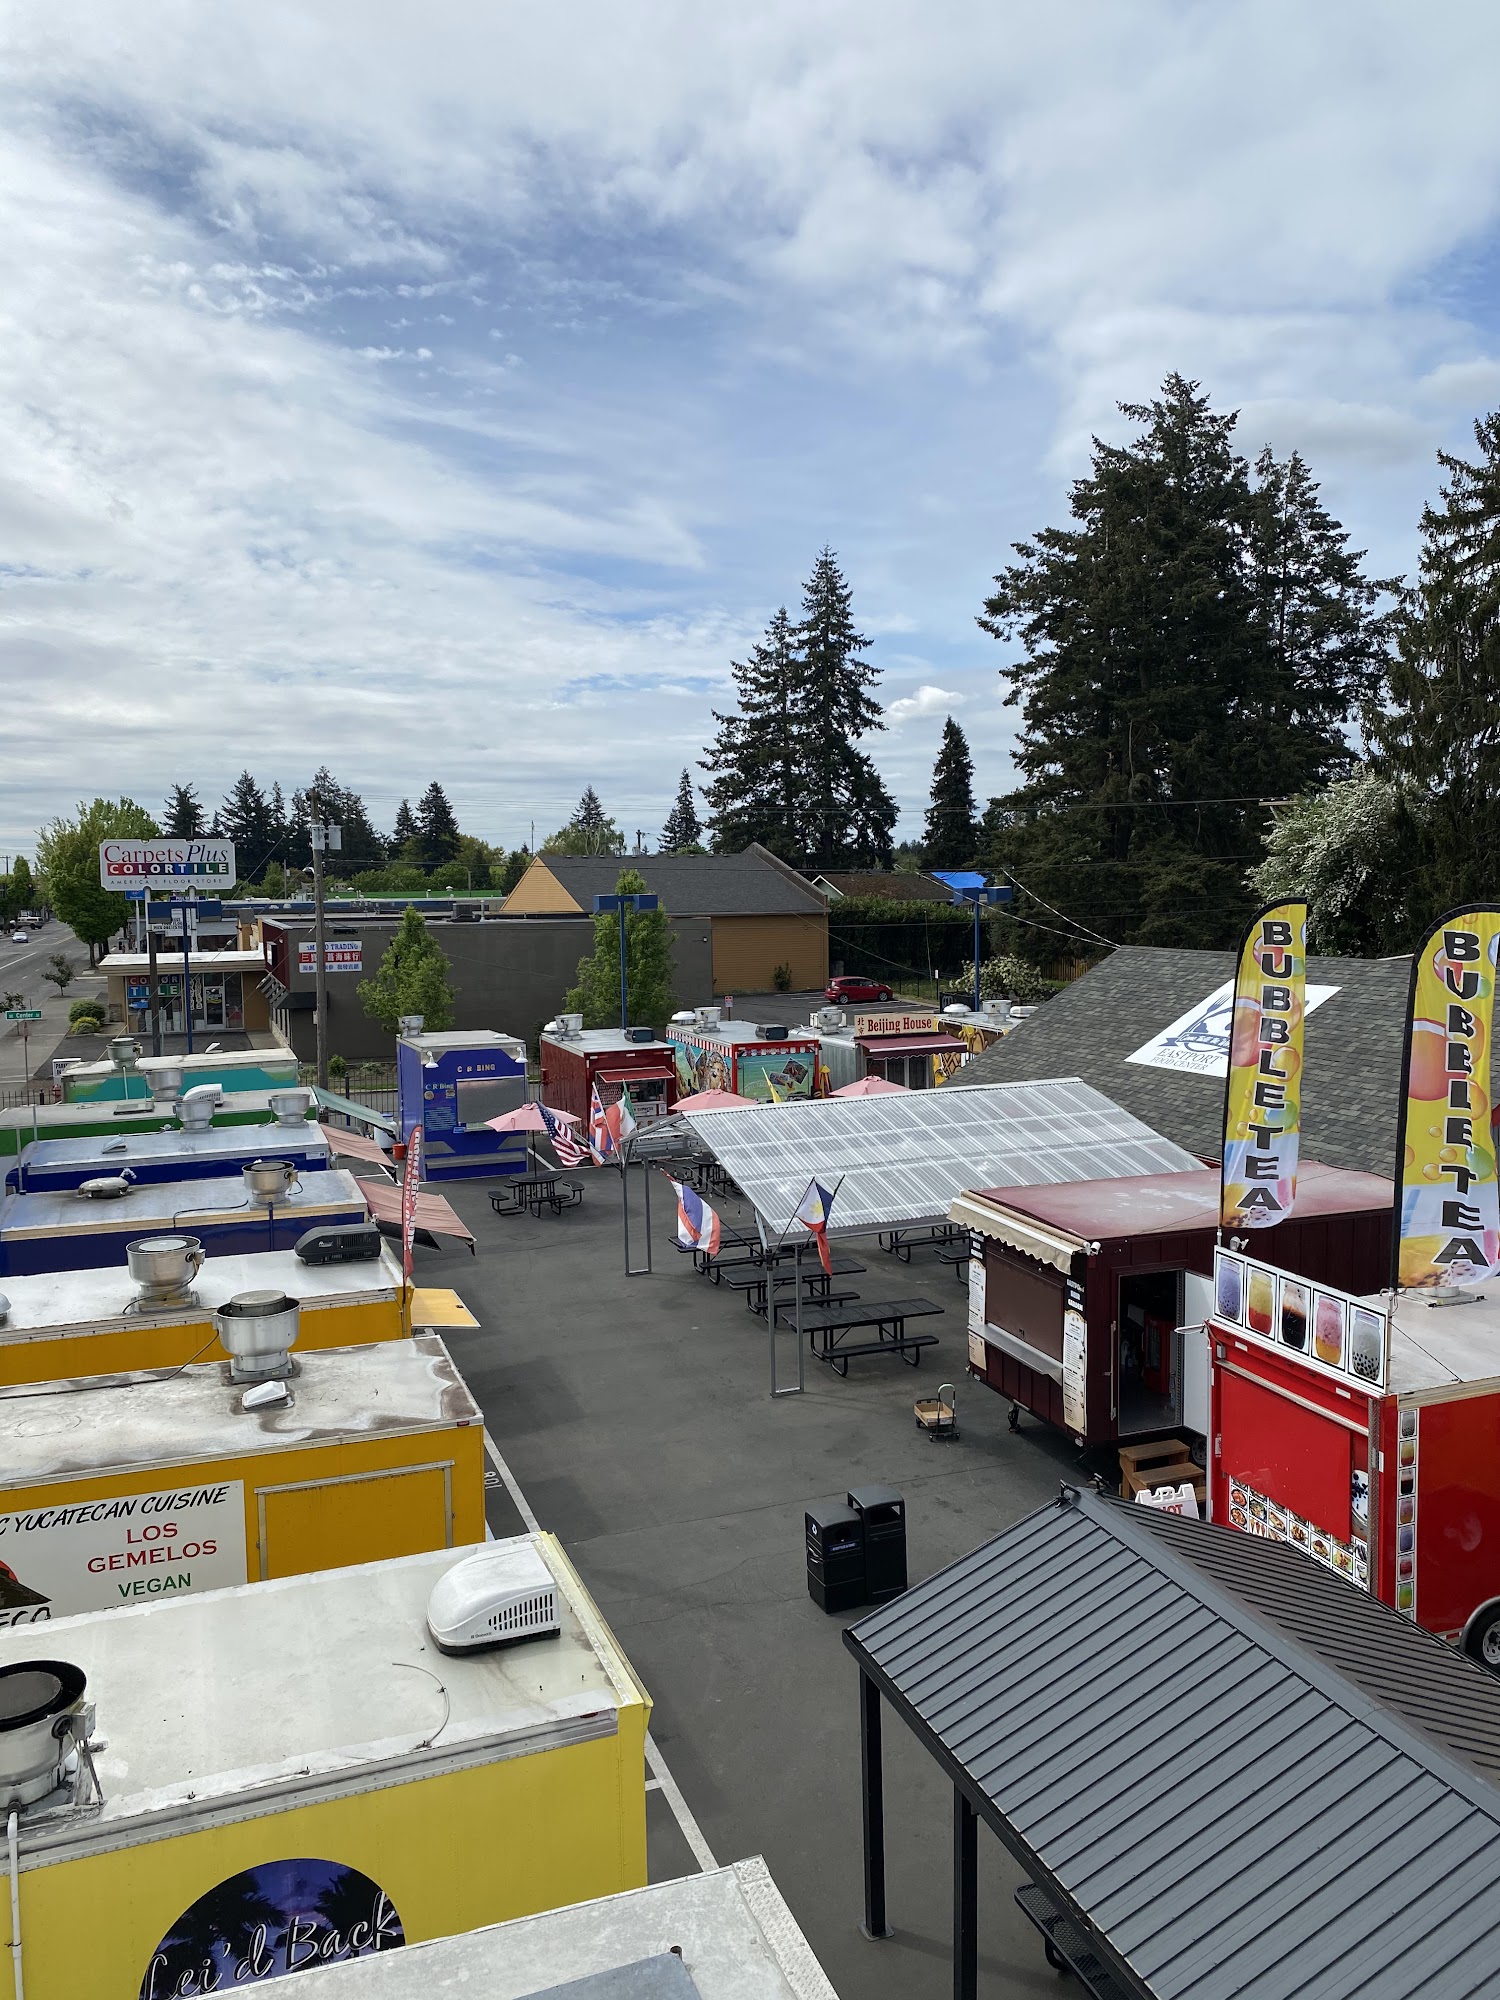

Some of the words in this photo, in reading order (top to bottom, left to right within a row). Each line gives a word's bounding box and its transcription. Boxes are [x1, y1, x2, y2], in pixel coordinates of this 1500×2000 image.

[104, 845, 184, 879] Carpets
[186, 845, 228, 862] Plus
[110, 864, 227, 874] COLORTILE
[130, 976, 178, 985] COOR
[130, 985, 178, 996] TILE
[867, 1018, 900, 1033] Beijing
[903, 1017, 932, 1030] House
[1254, 921, 1293, 1110] BUBBLE
[1157, 1048, 1222, 1064] EASTPORT
[1174, 1060, 1208, 1070] CENTER
[476, 1064, 496, 1072] BING
[439, 1082, 454, 1090] Bing
[1237, 1123, 1285, 1211] TEA
[1432, 1165, 1490, 1266] TEA
[15, 1499, 137, 1533] YUCATECAN
[141, 1486, 230, 1514] CUISINE
[126, 1522, 178, 1545] LOS
[87, 1540, 218, 1573] GEMELOS
[118, 1573, 191, 1598] VEGAN
[281, 1890, 397, 1971] Back
